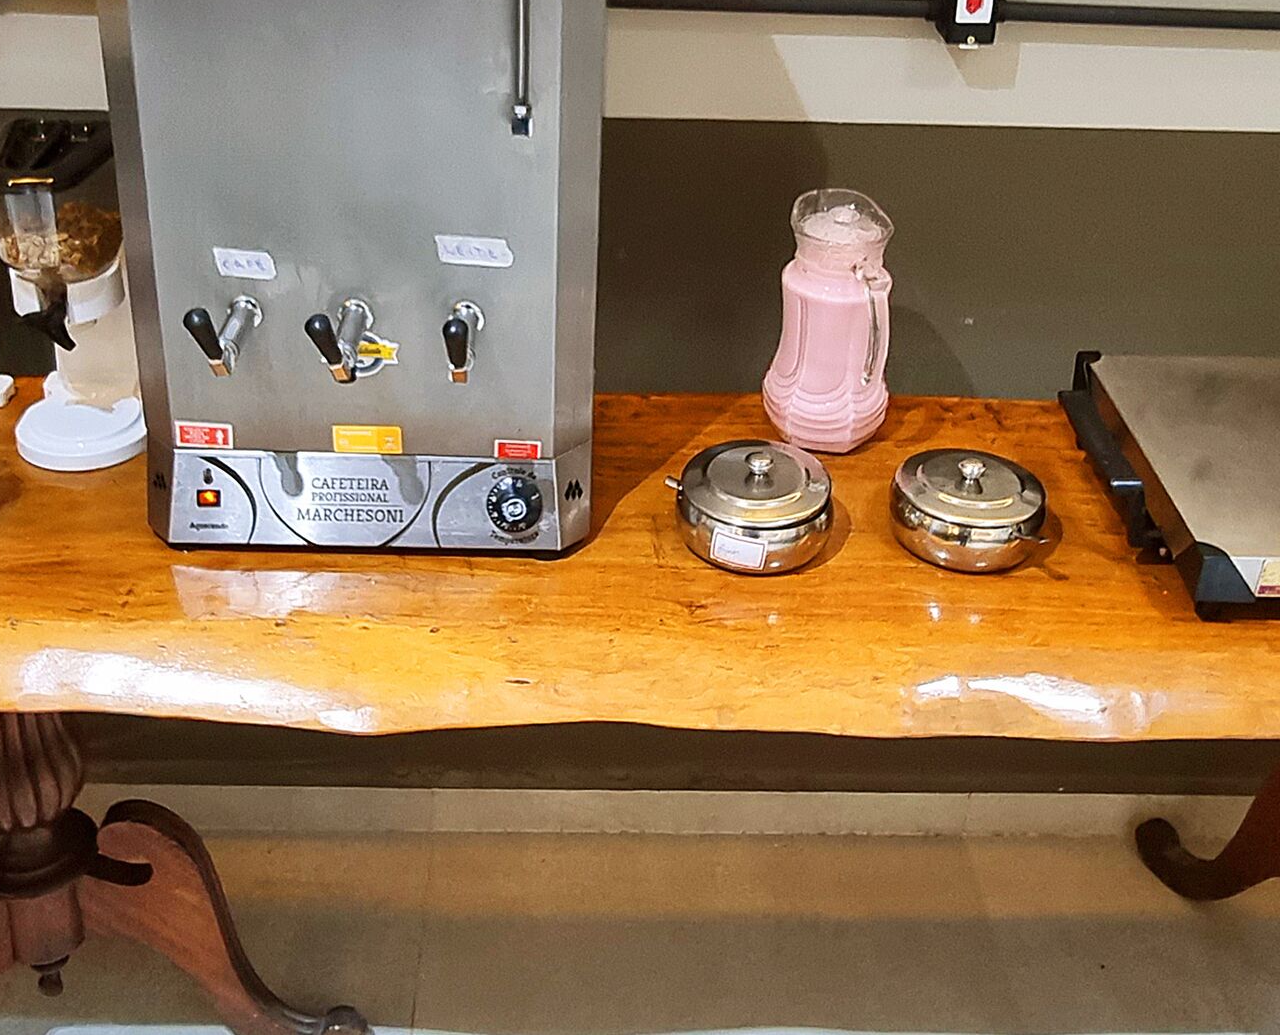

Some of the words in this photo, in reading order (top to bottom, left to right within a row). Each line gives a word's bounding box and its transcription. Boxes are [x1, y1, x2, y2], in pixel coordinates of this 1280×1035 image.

[311, 477, 389, 491] CAFETEIRA
[311, 491, 390, 503] PROFISSIONAL
[296, 507, 404, 523] MARCHESONI
